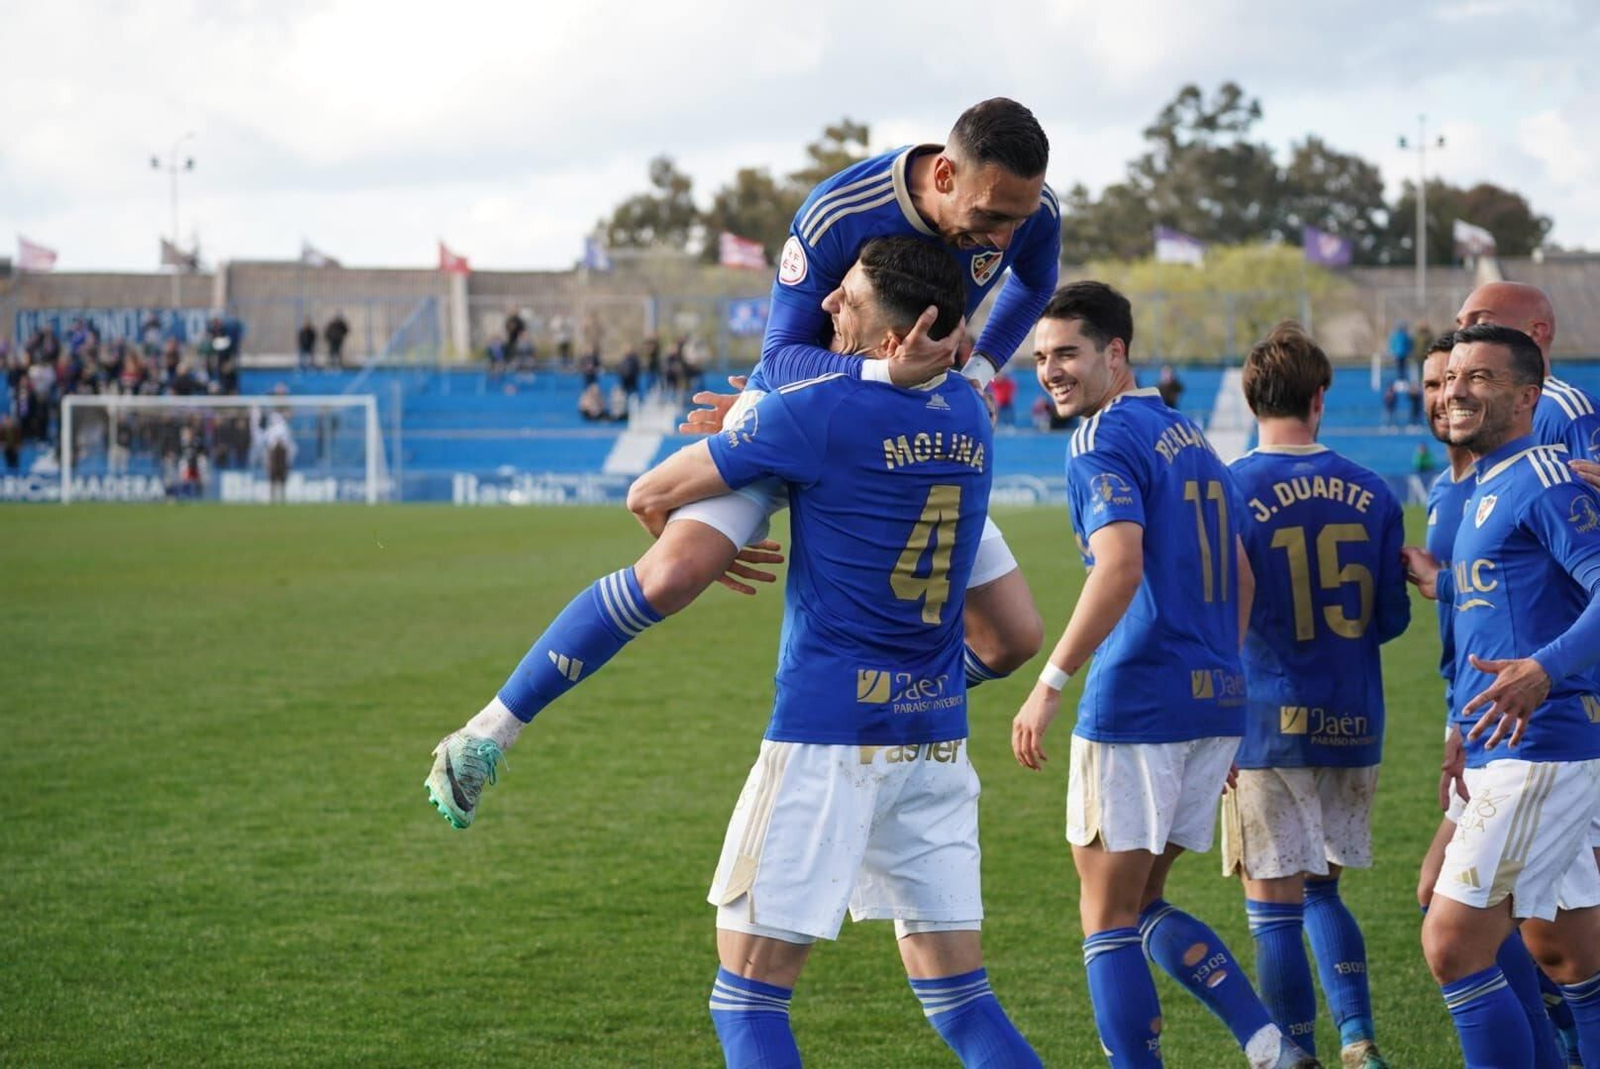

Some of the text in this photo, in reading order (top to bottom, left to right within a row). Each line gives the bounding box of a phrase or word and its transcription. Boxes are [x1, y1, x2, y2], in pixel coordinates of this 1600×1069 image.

[883, 432, 984, 473] MOLINA
[1273, 475, 1375, 513] DUARTE
[888, 485, 961, 625] 4
[1184, 480, 1229, 602] 11
[1271, 523, 1374, 641] 15
[1312, 708, 1367, 736] Jaén
[1192, 952, 1228, 983] 1909
